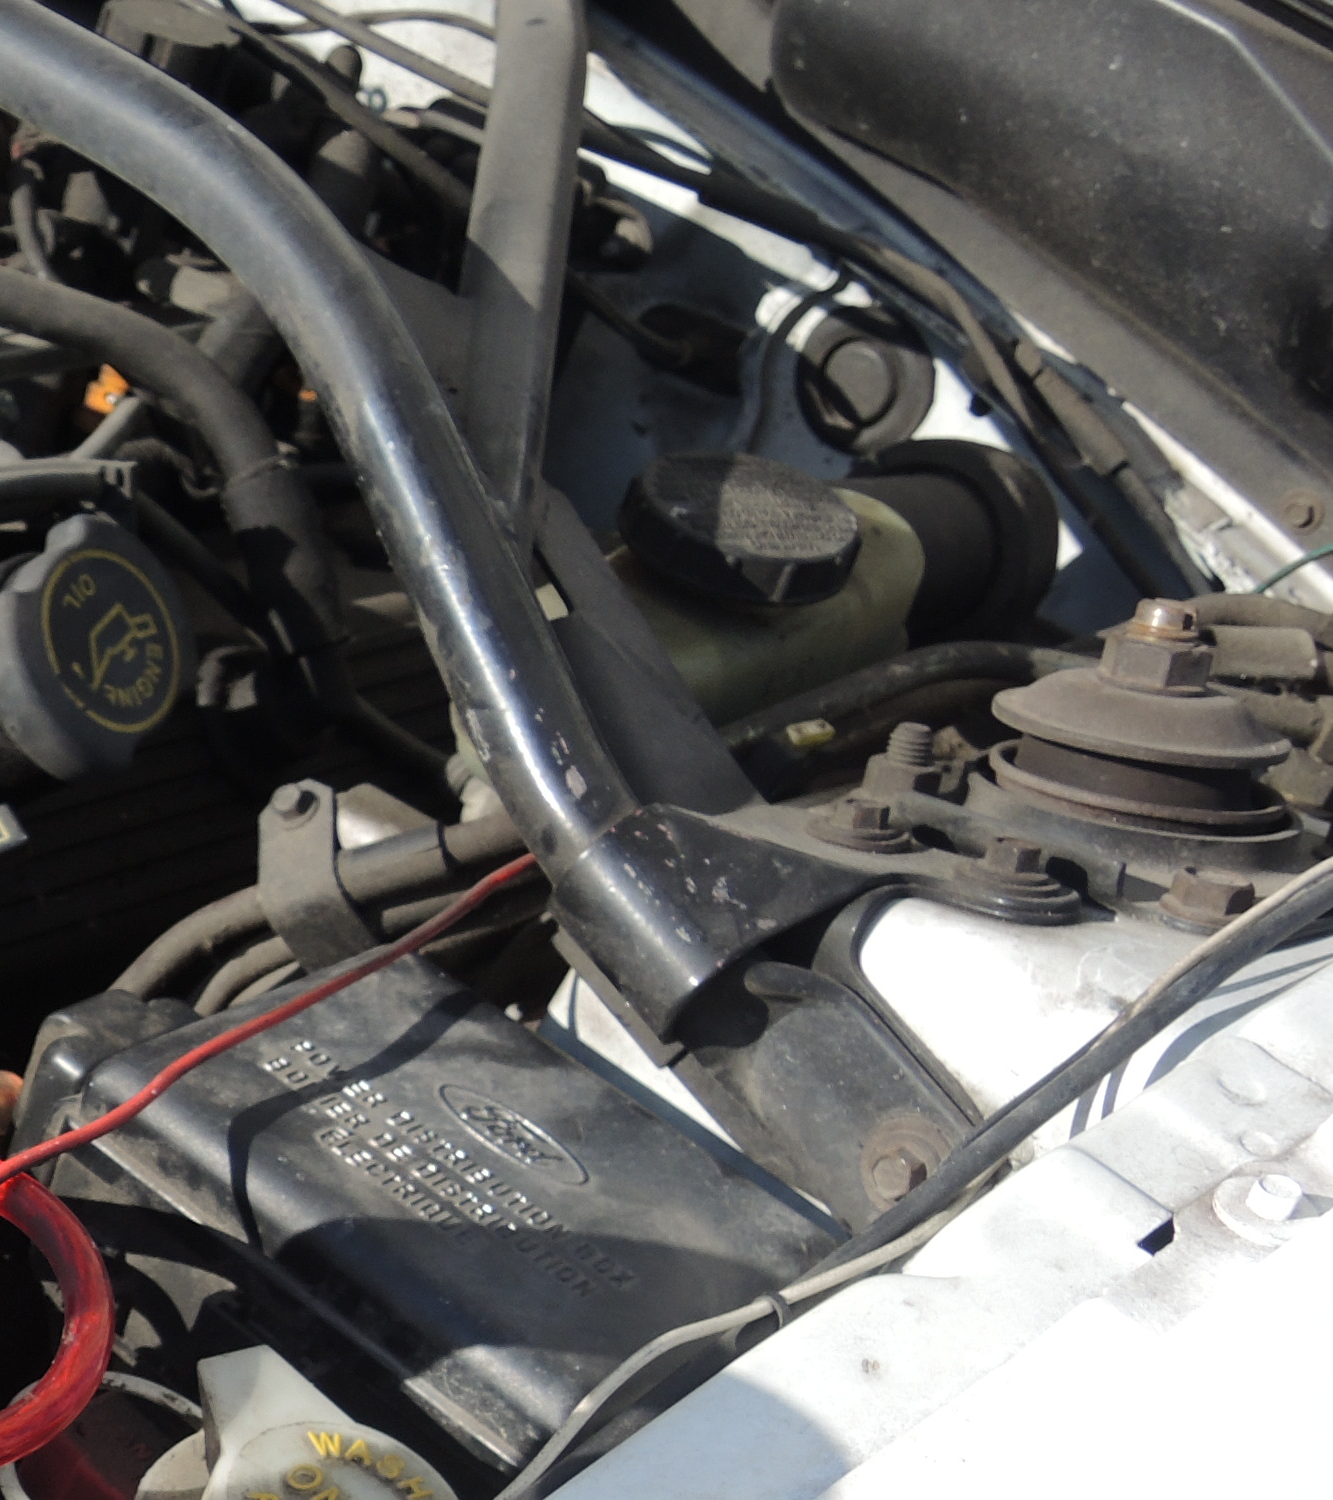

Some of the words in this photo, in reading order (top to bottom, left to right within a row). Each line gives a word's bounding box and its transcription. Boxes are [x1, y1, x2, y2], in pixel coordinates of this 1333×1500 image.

[64, 573, 96, 609] OIL
[103, 643, 163, 707] ENGINE
[461, 1106, 563, 1164] Ford
[368, 1131, 412, 1162] DE
[410, 1163, 597, 1296] DISTRIBUTION
[387, 1110, 571, 1240] DISTRIBUTION
[576, 1241, 634, 1286] BOX
